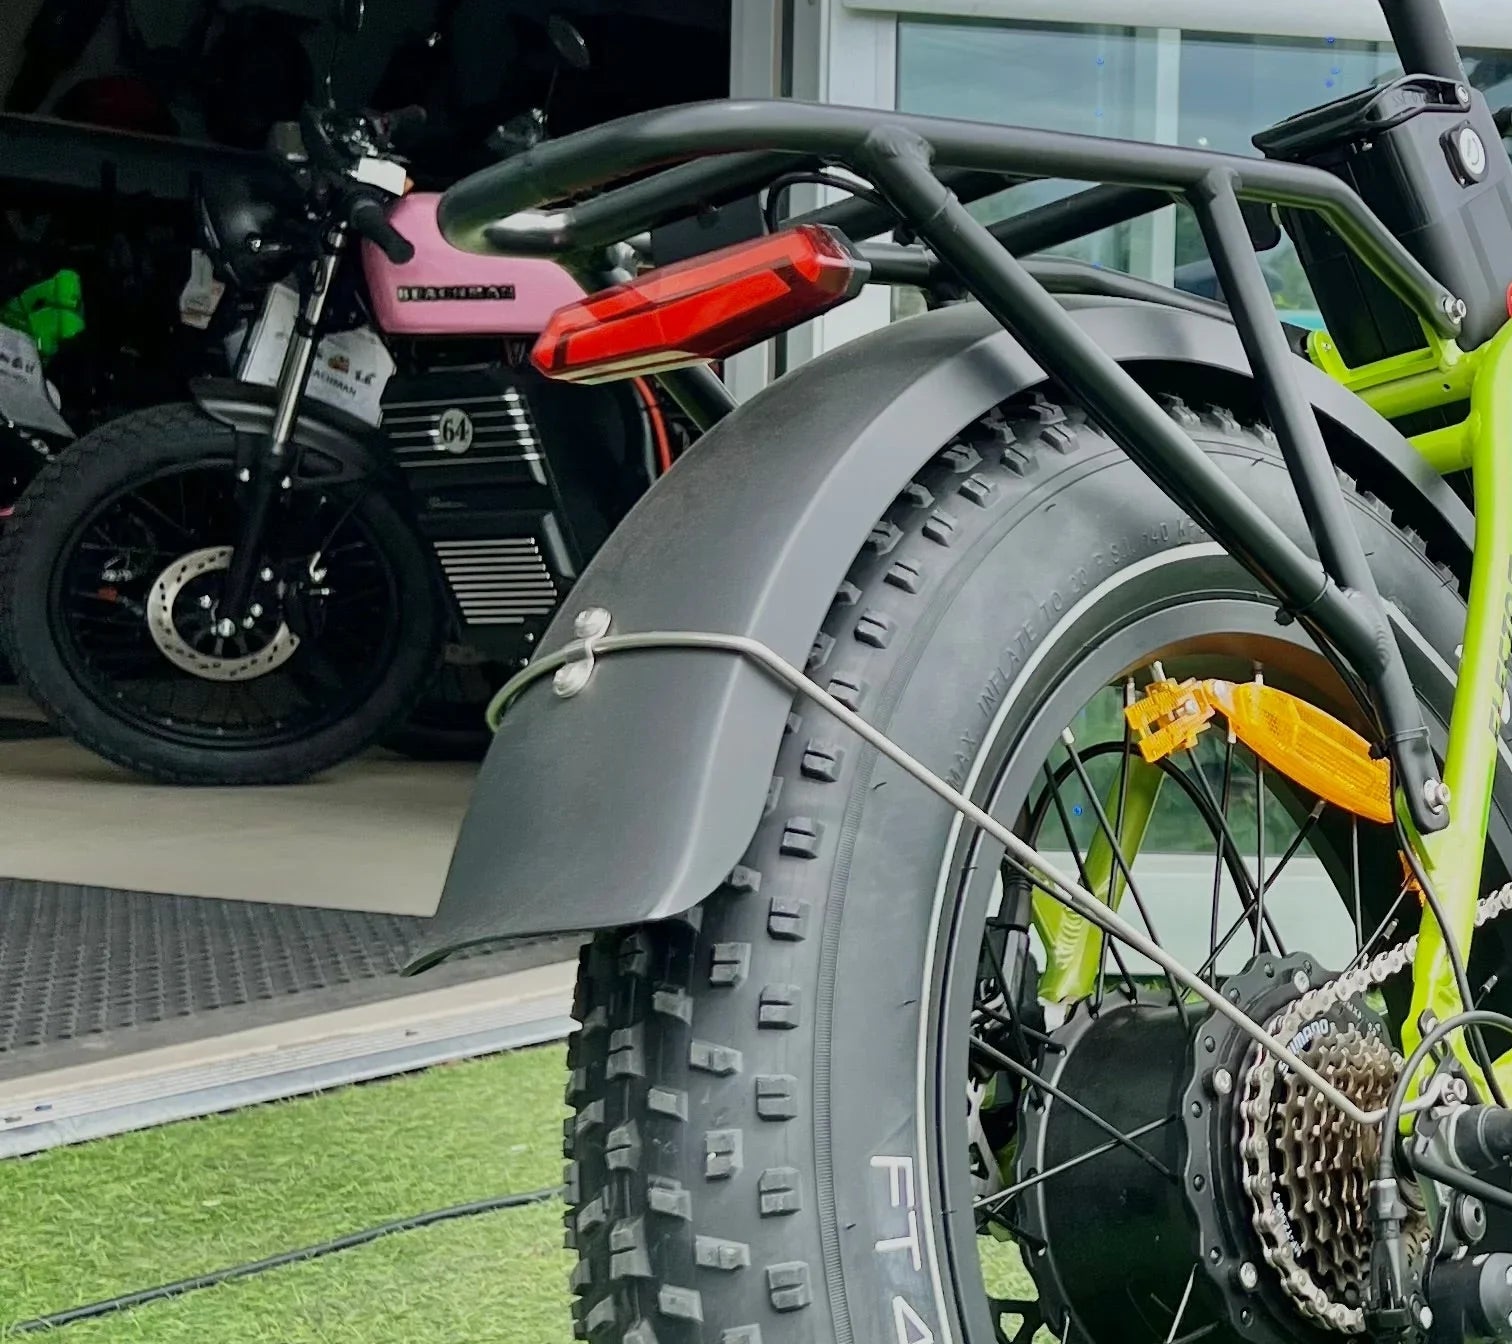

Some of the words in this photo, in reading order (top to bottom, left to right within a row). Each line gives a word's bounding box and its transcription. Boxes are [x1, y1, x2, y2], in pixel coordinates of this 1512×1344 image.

[443, 417, 470, 443] 64
[977, 618, 1038, 718] INFLATE
[1038, 590, 1064, 621] TO
